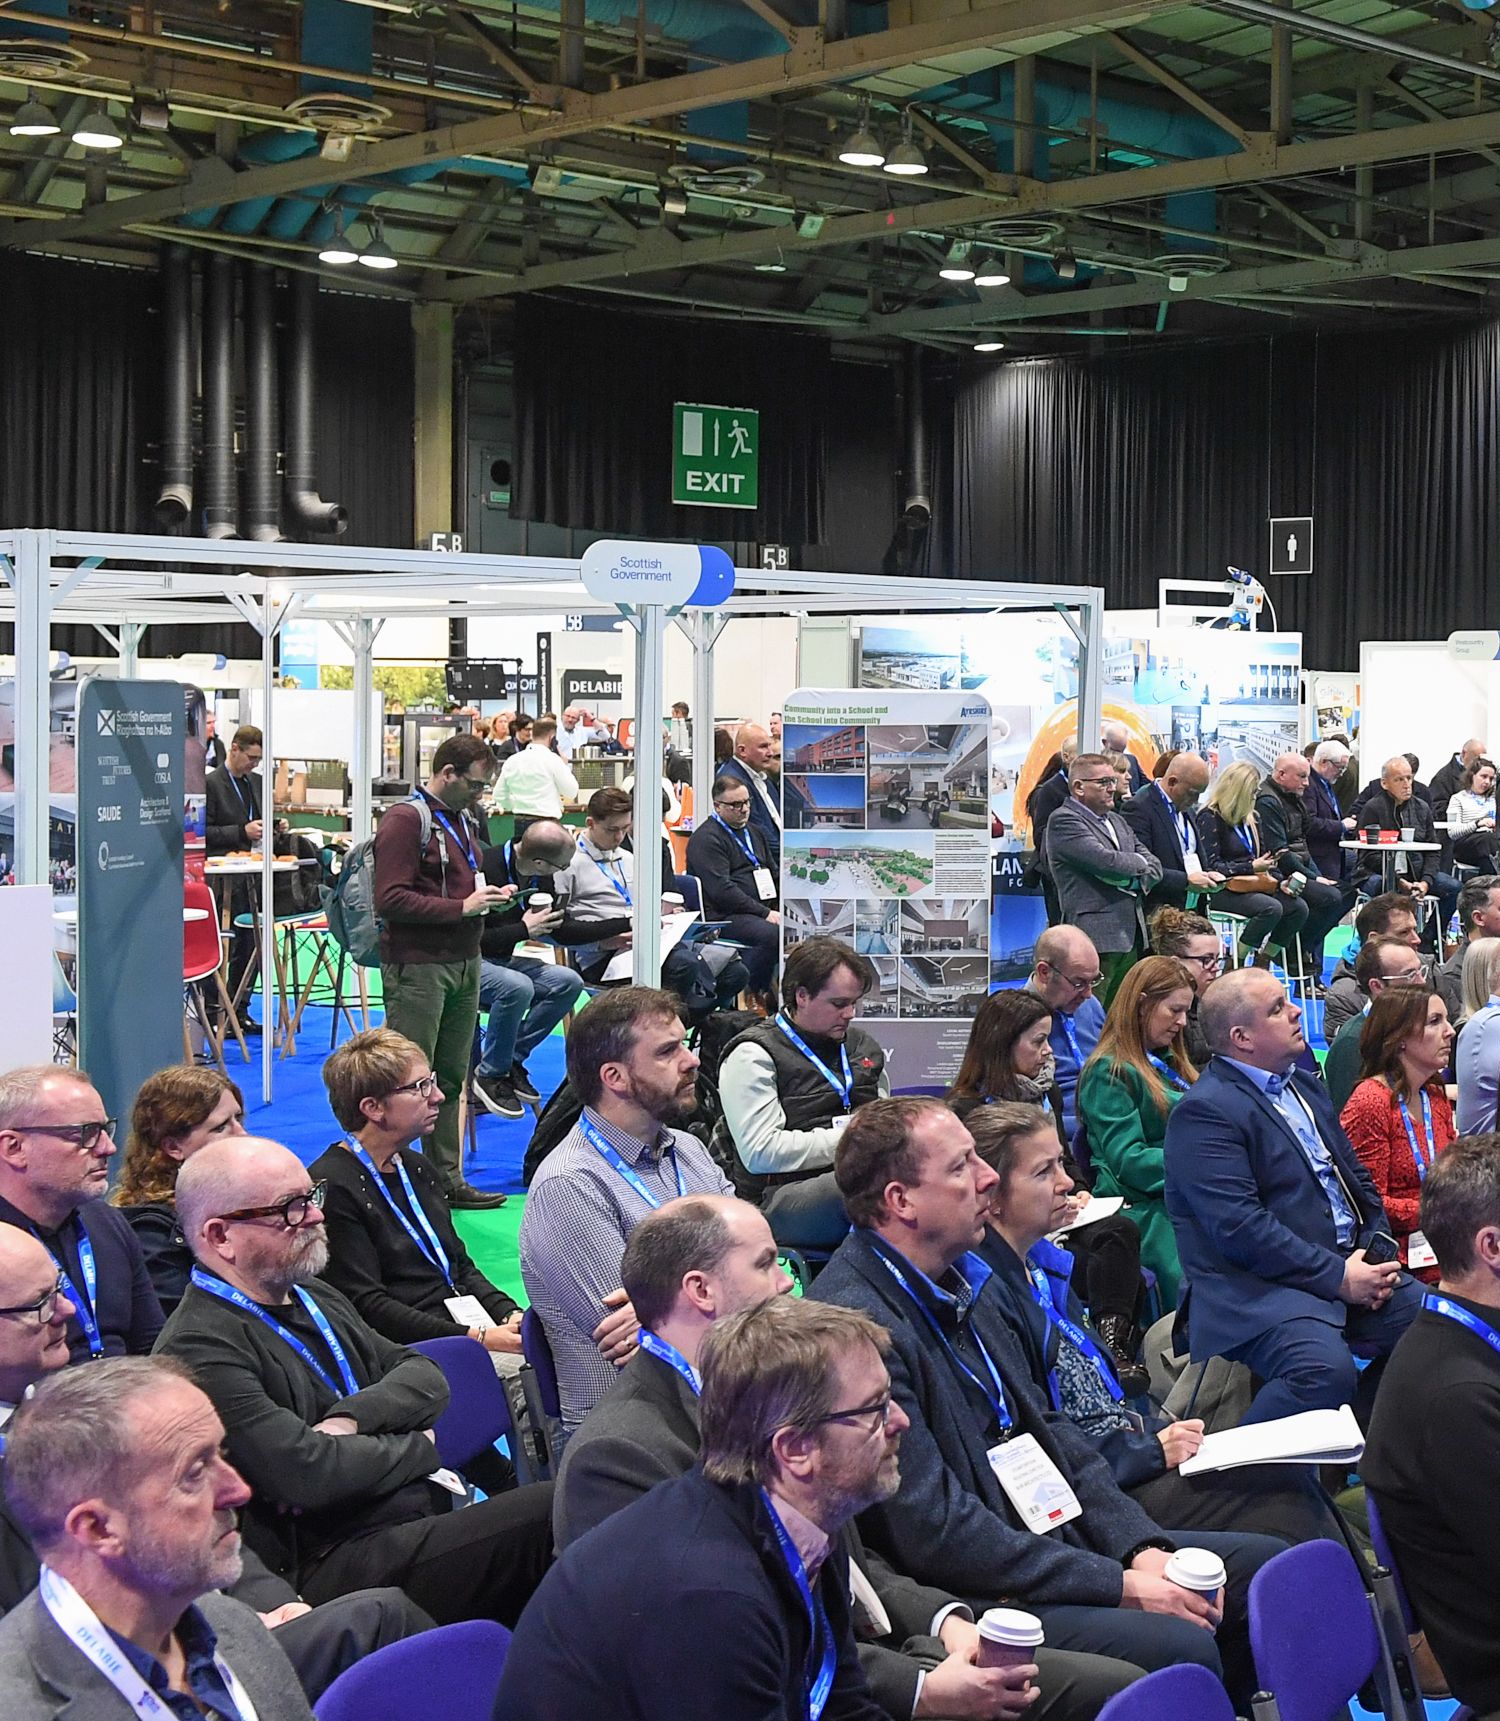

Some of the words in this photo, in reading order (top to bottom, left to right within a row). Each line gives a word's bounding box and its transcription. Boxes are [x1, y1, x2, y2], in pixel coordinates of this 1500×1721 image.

[686, 471, 745, 495] EXIT
[620, 556, 662, 569] Scottish
[610, 568, 672, 582] Government
[569, 680, 623, 694] DELABIE
[116, 710, 139, 723] Scottish
[139, 710, 172, 723] Government
[784, 704, 825, 714] Community
[848, 706, 873, 714] School
[875, 706, 888, 714] and
[784, 715, 795, 723] the
[797, 716, 822, 724] School
[840, 717, 881, 725] Community
[97, 806, 121, 822] SAUDE
[588, 1129, 609, 1153] DELABIE
[231, 1292, 265, 1317] DELABIE
[1058, 1319, 1083, 1345] DELABIE
[324, 1328, 344, 1361] DELABIE
[302, 1348, 327, 1377] DELABIE
[77, 1626, 123, 1676] DELABIE
